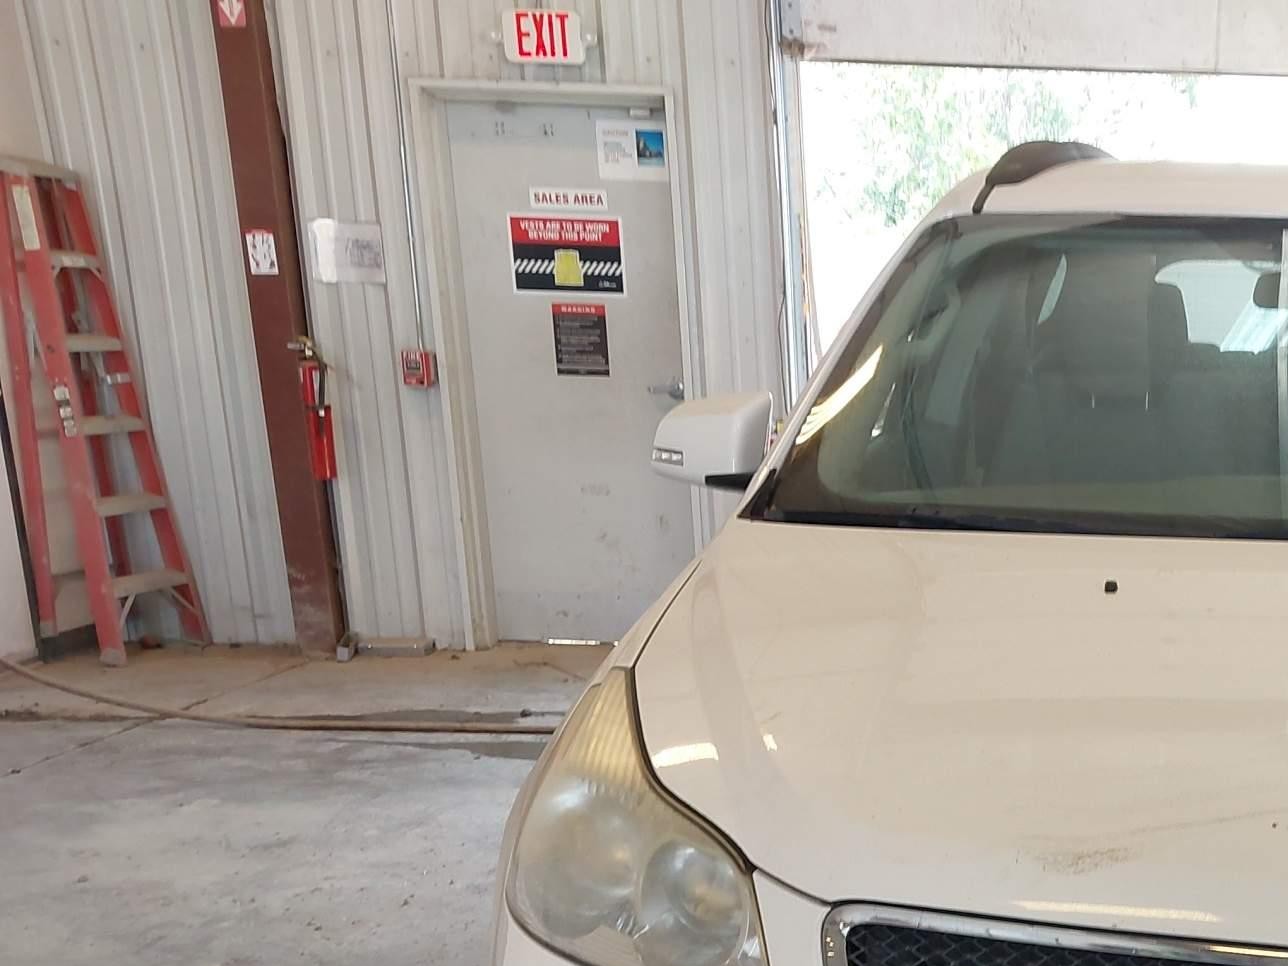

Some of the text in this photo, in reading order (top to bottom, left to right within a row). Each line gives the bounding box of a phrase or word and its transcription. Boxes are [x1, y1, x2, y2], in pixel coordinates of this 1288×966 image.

[514, 13, 569, 57] EXIT
[533, 190, 604, 206] SALES AREA
[519, 219, 610, 233] VESTS ARE TO BE WORN
[528, 229, 603, 242] BEYOND THIS POINT
